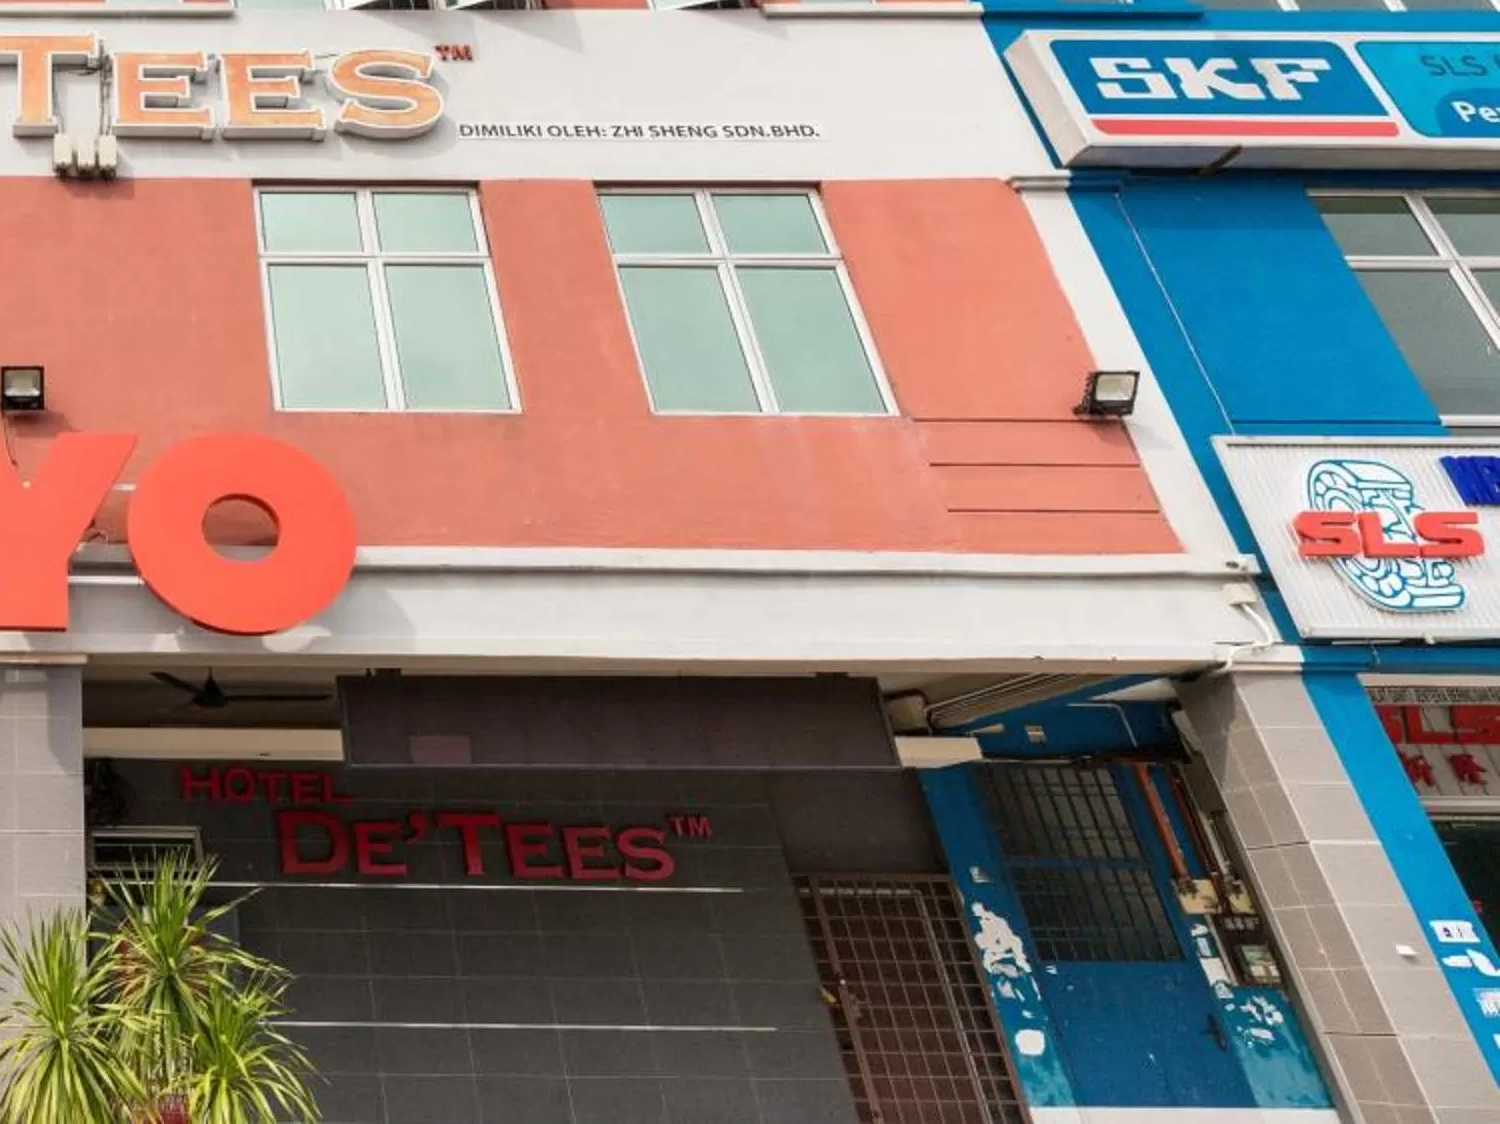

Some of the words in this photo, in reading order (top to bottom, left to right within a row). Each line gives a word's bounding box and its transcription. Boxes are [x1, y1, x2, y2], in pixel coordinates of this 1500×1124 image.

[1089, 57, 1332, 100] SKF
[1420, 55, 1487, 77] SLS
[1450, 101, 1500, 124] Pe
[459, 124, 542, 138] DIMILIKI
[546, 124, 608, 138] OLEH:
[612, 124, 645, 138] ZHI
[648, 124, 719, 138] SHENG
[722, 124, 821, 138] SDN.BHD.
[1293, 511, 1485, 559] SLS
[180, 765, 353, 807] HOTEL
